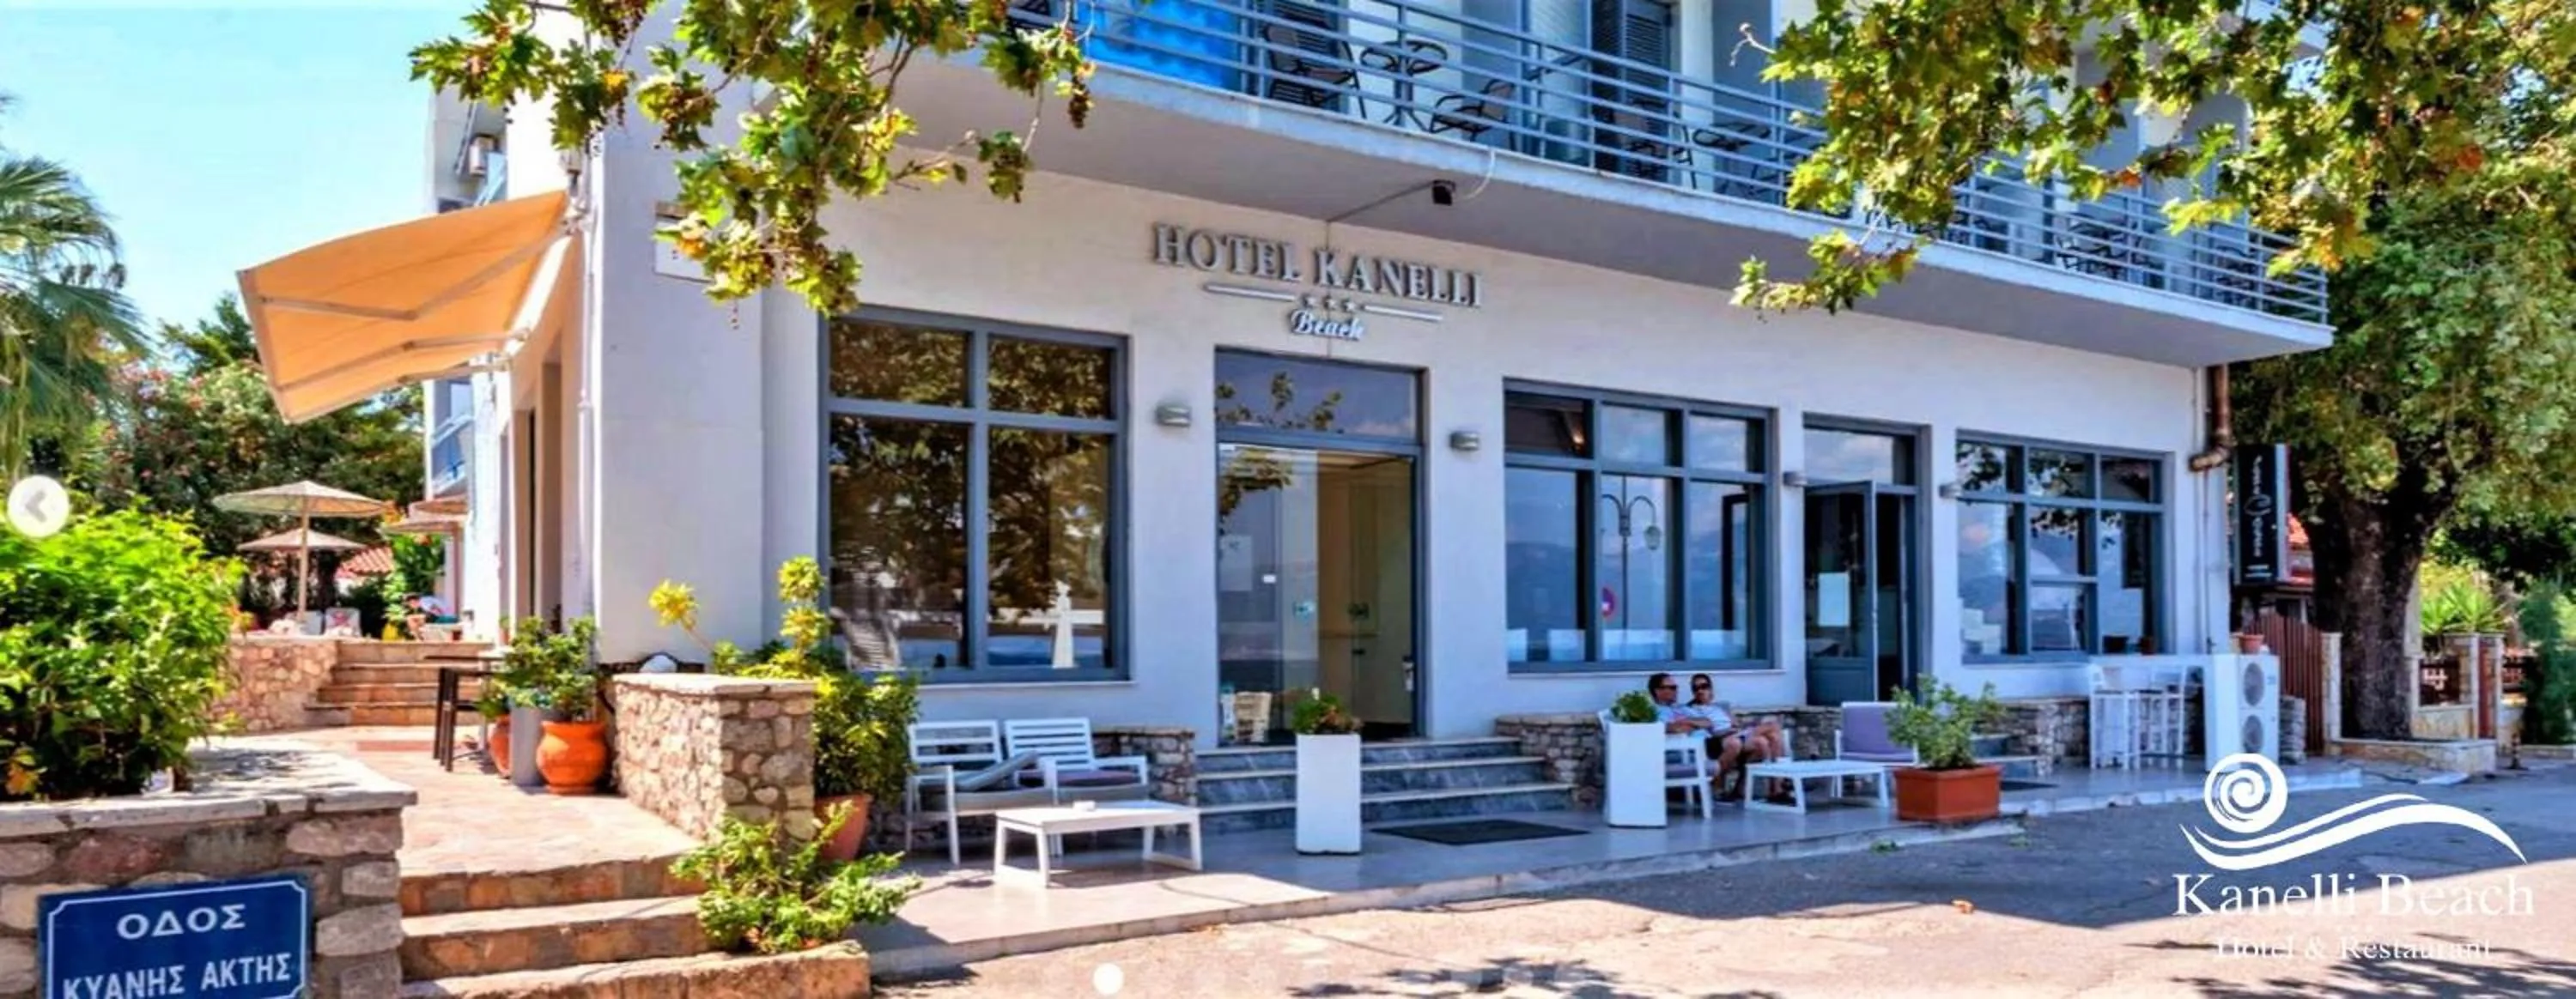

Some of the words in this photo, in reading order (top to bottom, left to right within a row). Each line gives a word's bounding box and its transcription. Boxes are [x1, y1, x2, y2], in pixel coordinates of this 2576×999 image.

[1152, 221, 1303, 283] HOTEL
[1313, 246, 1484, 308] KANELLI
[1289, 308, 1365, 341] Beach
[116, 903, 246, 940] ΟΔΟΣ
[63, 964, 186, 999] ΚΥΑΝΗΣ
[200, 952, 291, 991] ΑΚΤΗΣ
